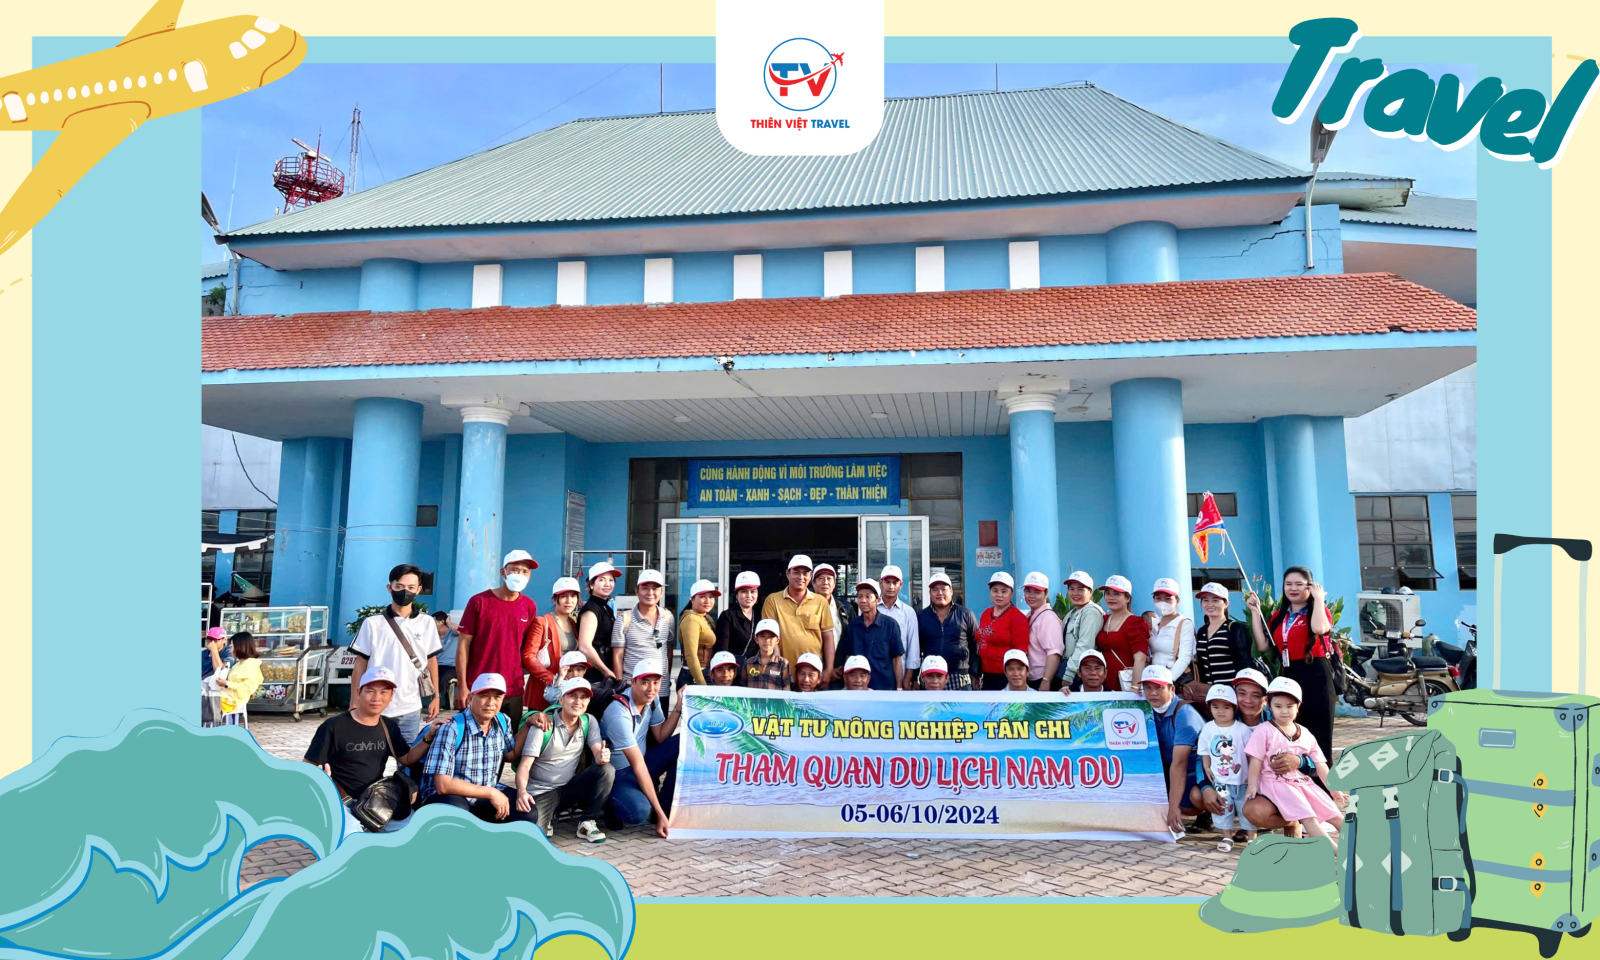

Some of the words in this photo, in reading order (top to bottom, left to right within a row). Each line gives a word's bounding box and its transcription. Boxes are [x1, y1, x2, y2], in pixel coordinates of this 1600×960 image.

[700, 465, 724, 481] CÙNG
[726, 464, 750, 480] HÀNH
[752, 464, 777, 483] ĐỘNG
[778, 463, 788, 480] VÌ
[789, 464, 807, 480] MÔI
[808, 462, 844, 479] TRƯỜNG
[846, 461, 865, 478] LÀM
[867, 461, 888, 480] VIỆC
[700, 489, 713, 502] AN
[714, 486, 738, 501] TOÀN
[745, 488, 770, 501] XANH
[778, 487, 802, 504] SẠCH
[809, 487, 827, 503] ĐẸP
[835, 484, 859, 500] THÂN
[861, 483, 888, 502] THIỆN
[752, 714, 794, 741] VẬT
[799, 716, 830, 738] TƯ
[833, 716, 894, 739] NÔNG
[899, 717, 979, 743] NGHIỆP
[983, 718, 1030, 740] TÂN
[1034, 719, 1072, 740] CHI
[715, 752, 798, 787] THAM
[803, 754, 884, 790] QUAN
[889, 755, 931, 788] DU
[936, 755, 1000, 795] LỊCH
[1005, 755, 1074, 789] NAM
[1077, 755, 1124, 789] DU
[841, 804, 1000, 825] 05-06/10/2024
